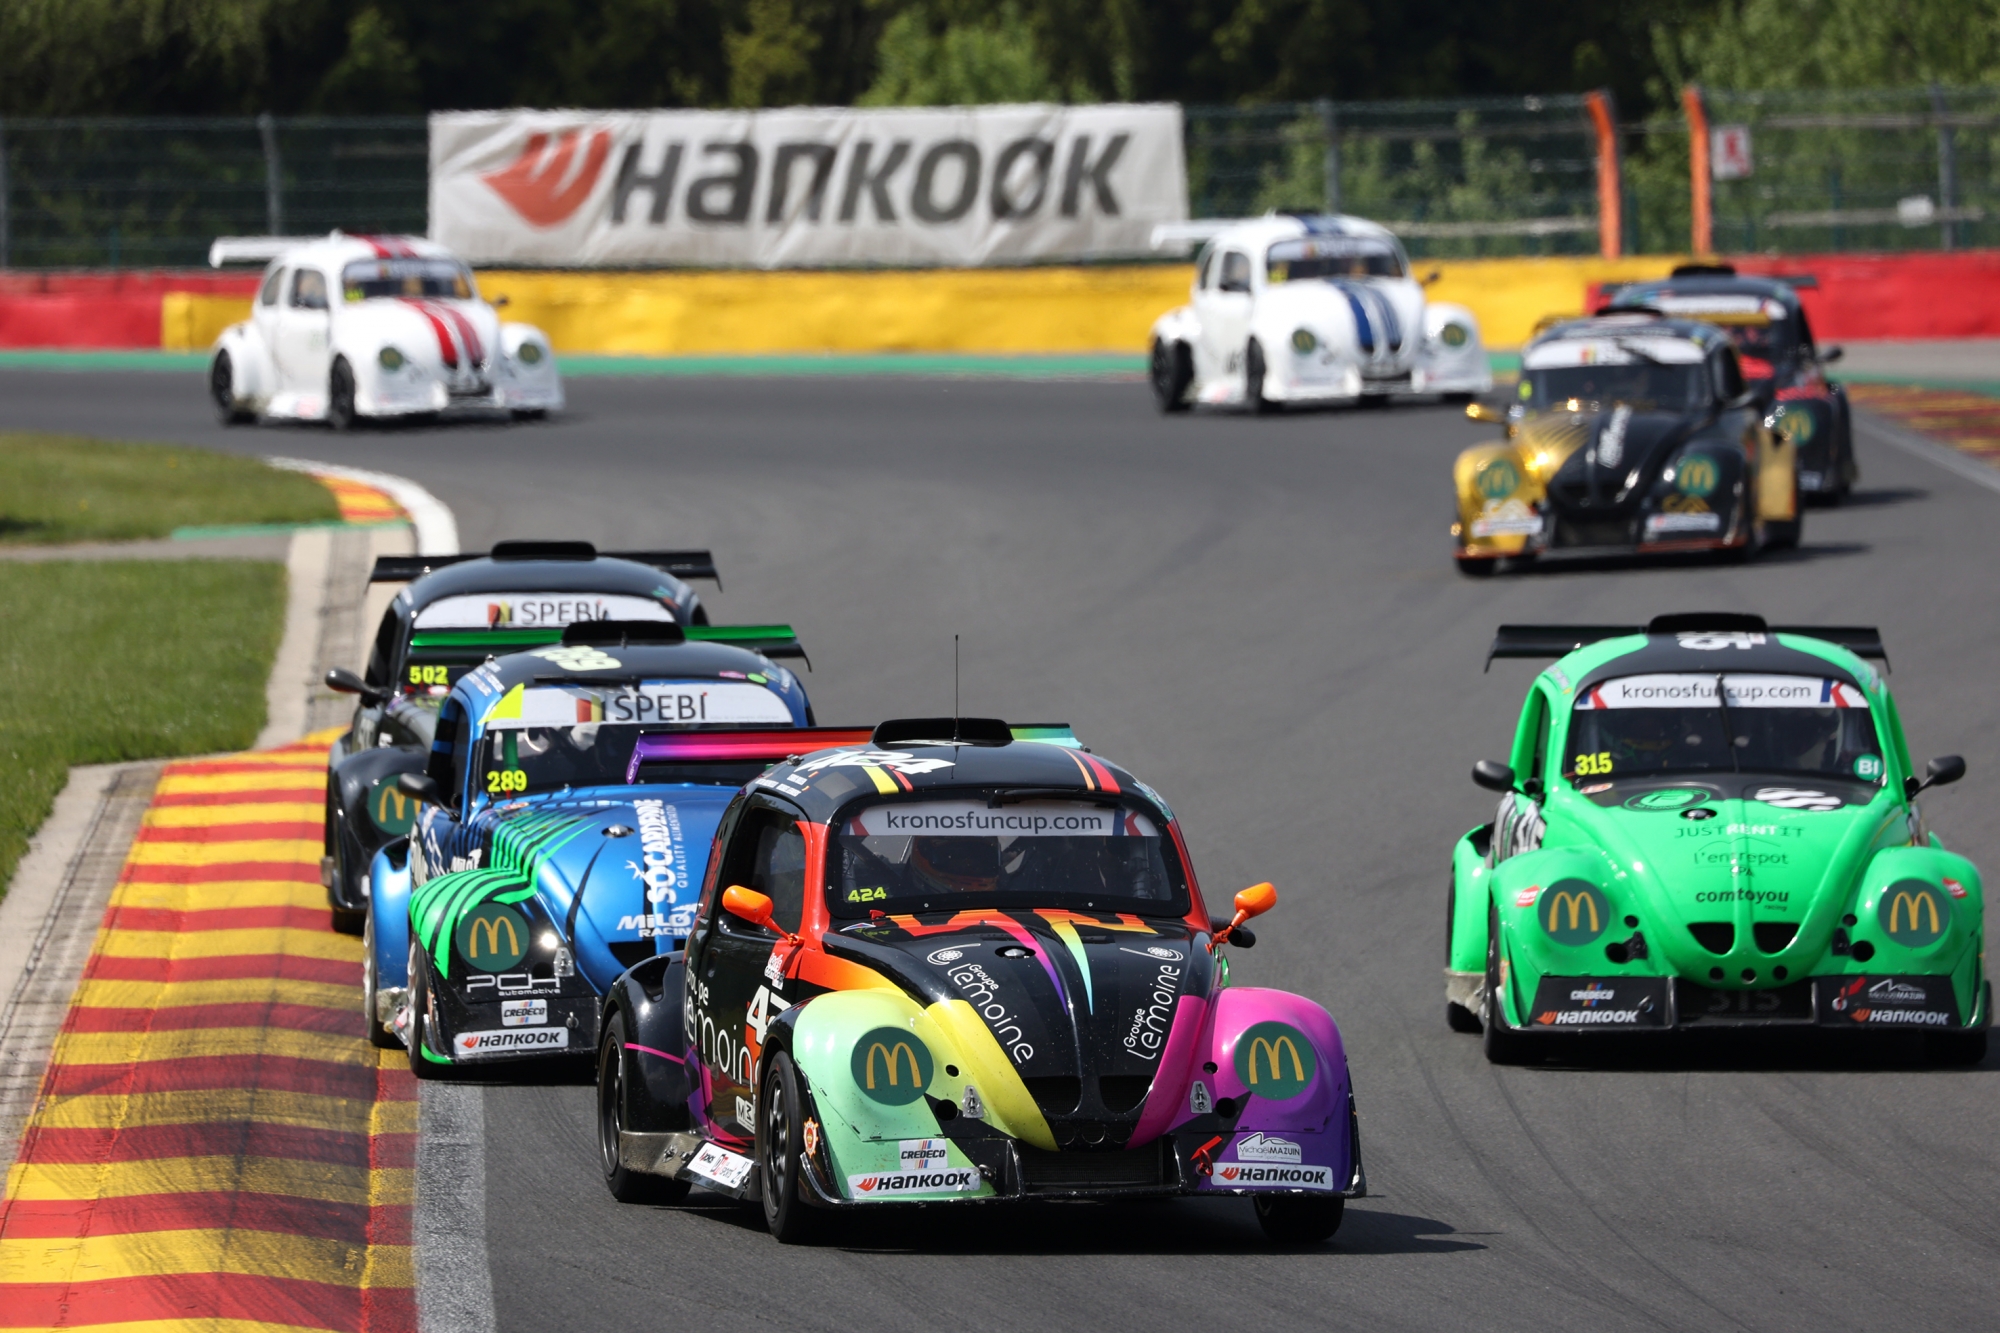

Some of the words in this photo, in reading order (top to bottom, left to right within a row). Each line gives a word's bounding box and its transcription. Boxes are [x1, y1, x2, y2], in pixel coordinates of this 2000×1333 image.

[409, 665, 448, 685] 502
[1574, 751, 1613, 776] 315
[487, 769, 527, 792] 289
[886, 810, 1102, 834] kronosfuncup.com
[673, 844, 688, 889] QUALITY
[848, 886, 887, 903] 424
[1695, 887, 1789, 904] comtoyou
[1764, 904, 1787, 912] racing
[638, 927, 693, 938] RACIN
[969, 964, 999, 991] Groupe
[498, 988, 561, 996] automotive
[1570, 989, 1615, 1000] CREDECO
[504, 1007, 546, 1017] CREDECO
[1123, 1008, 1146, 1048] Groupe
[901, 1149, 945, 1160] CREDECO
